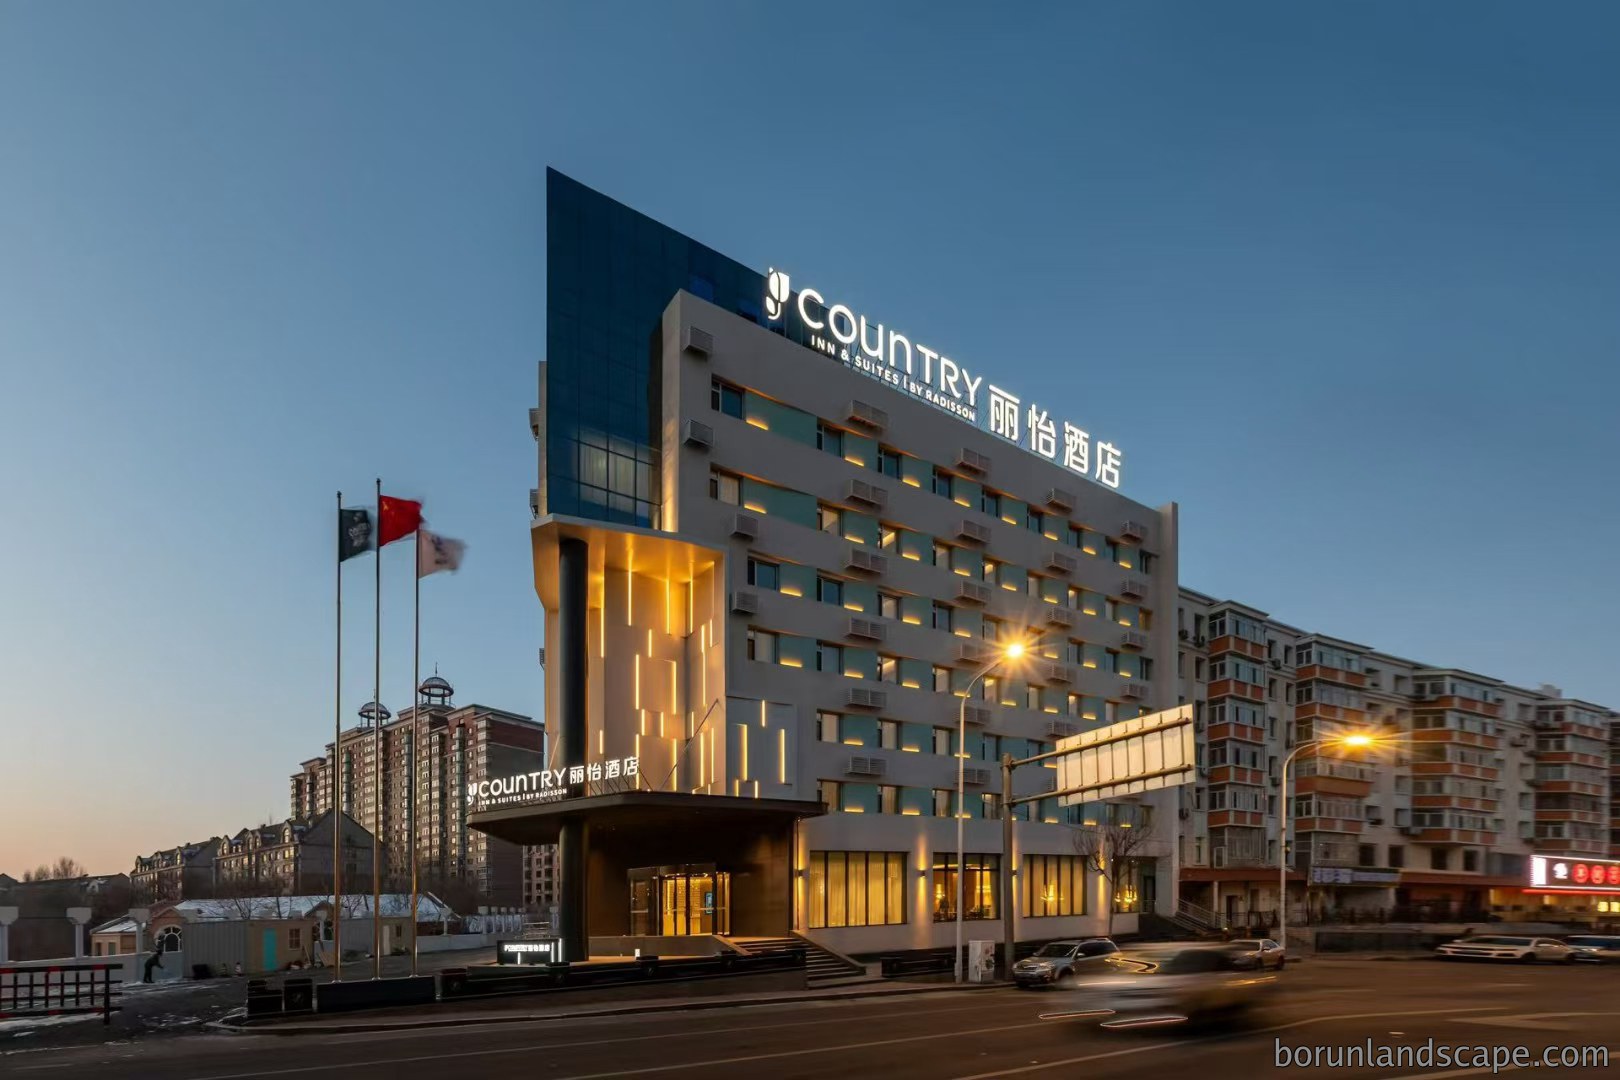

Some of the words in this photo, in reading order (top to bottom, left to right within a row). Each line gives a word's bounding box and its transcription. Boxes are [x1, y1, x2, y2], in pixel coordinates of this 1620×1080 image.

[811, 334, 836, 356] INN
[840, 348, 850, 362] &
[855, 355, 899, 386] SUITES
[909, 382, 923, 397] BY
[926, 390, 976, 422] RADISSON
[988, 383, 1122, 490] 丽怡酒店
[497, 794, 521, 804] SUITES
[535, 788, 568, 798] RADISSON
[569, 756, 640, 785] 丽怡酒店
